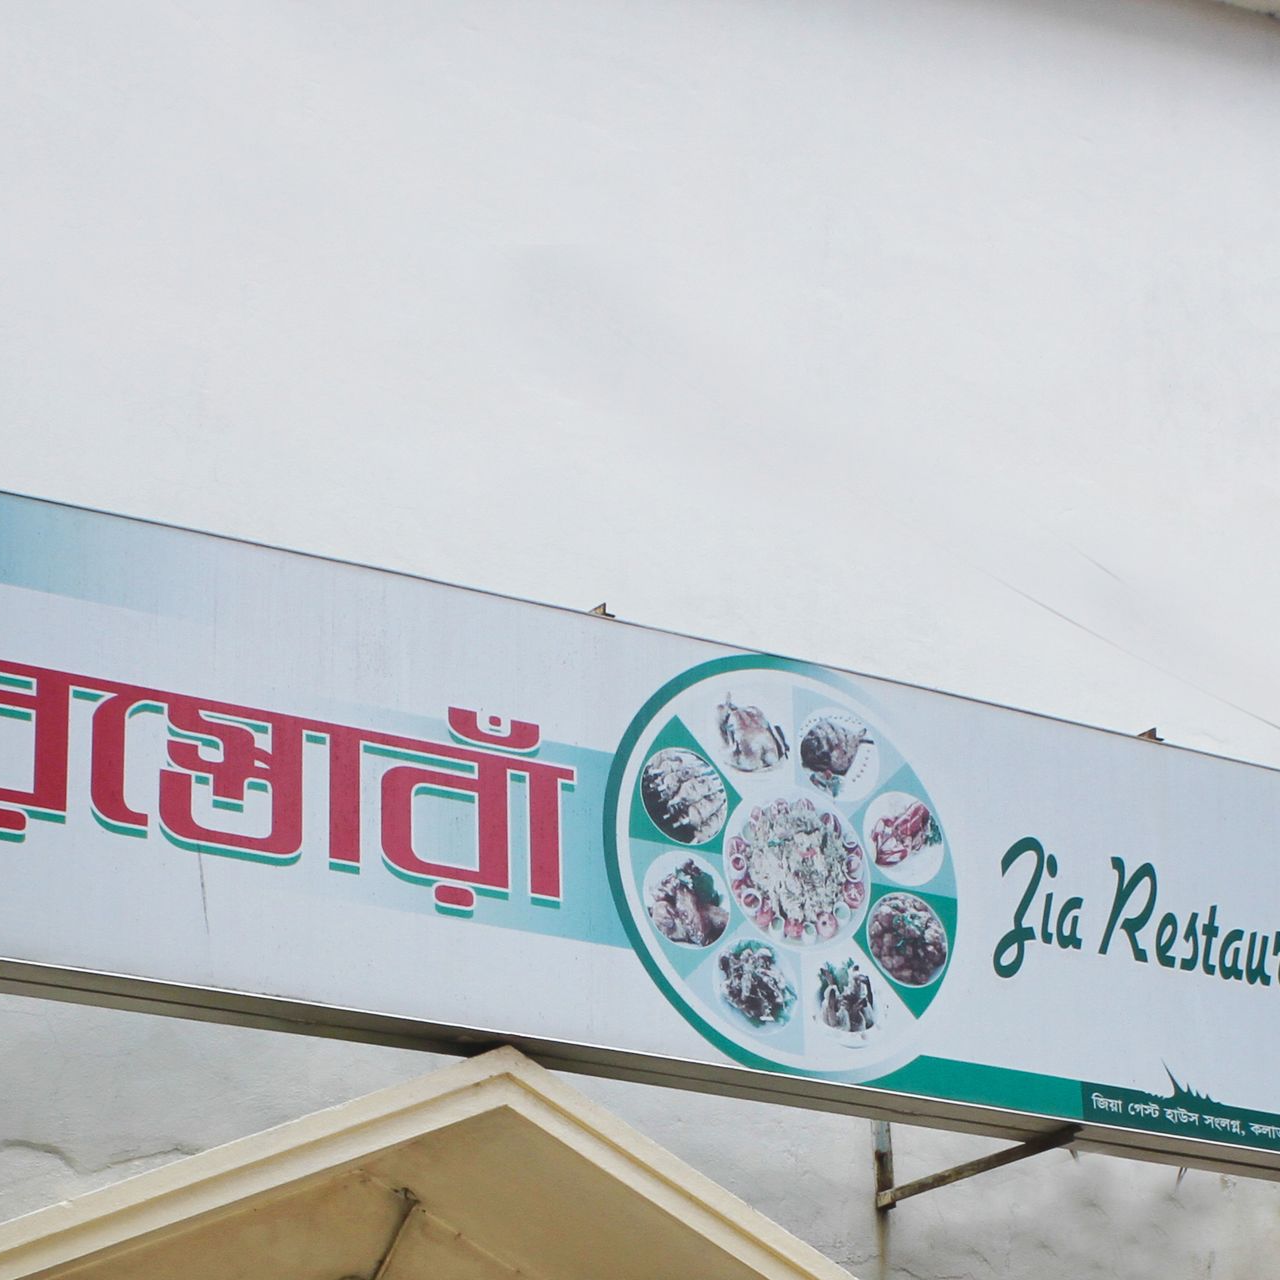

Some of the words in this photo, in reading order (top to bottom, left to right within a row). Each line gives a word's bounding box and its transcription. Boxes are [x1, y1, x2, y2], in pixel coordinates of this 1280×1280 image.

[993, 836, 1084, 978] Zia
[1091, 1092, 1123, 1113] জিয়া
[1165, 1106, 1199, 1126] হাউস
